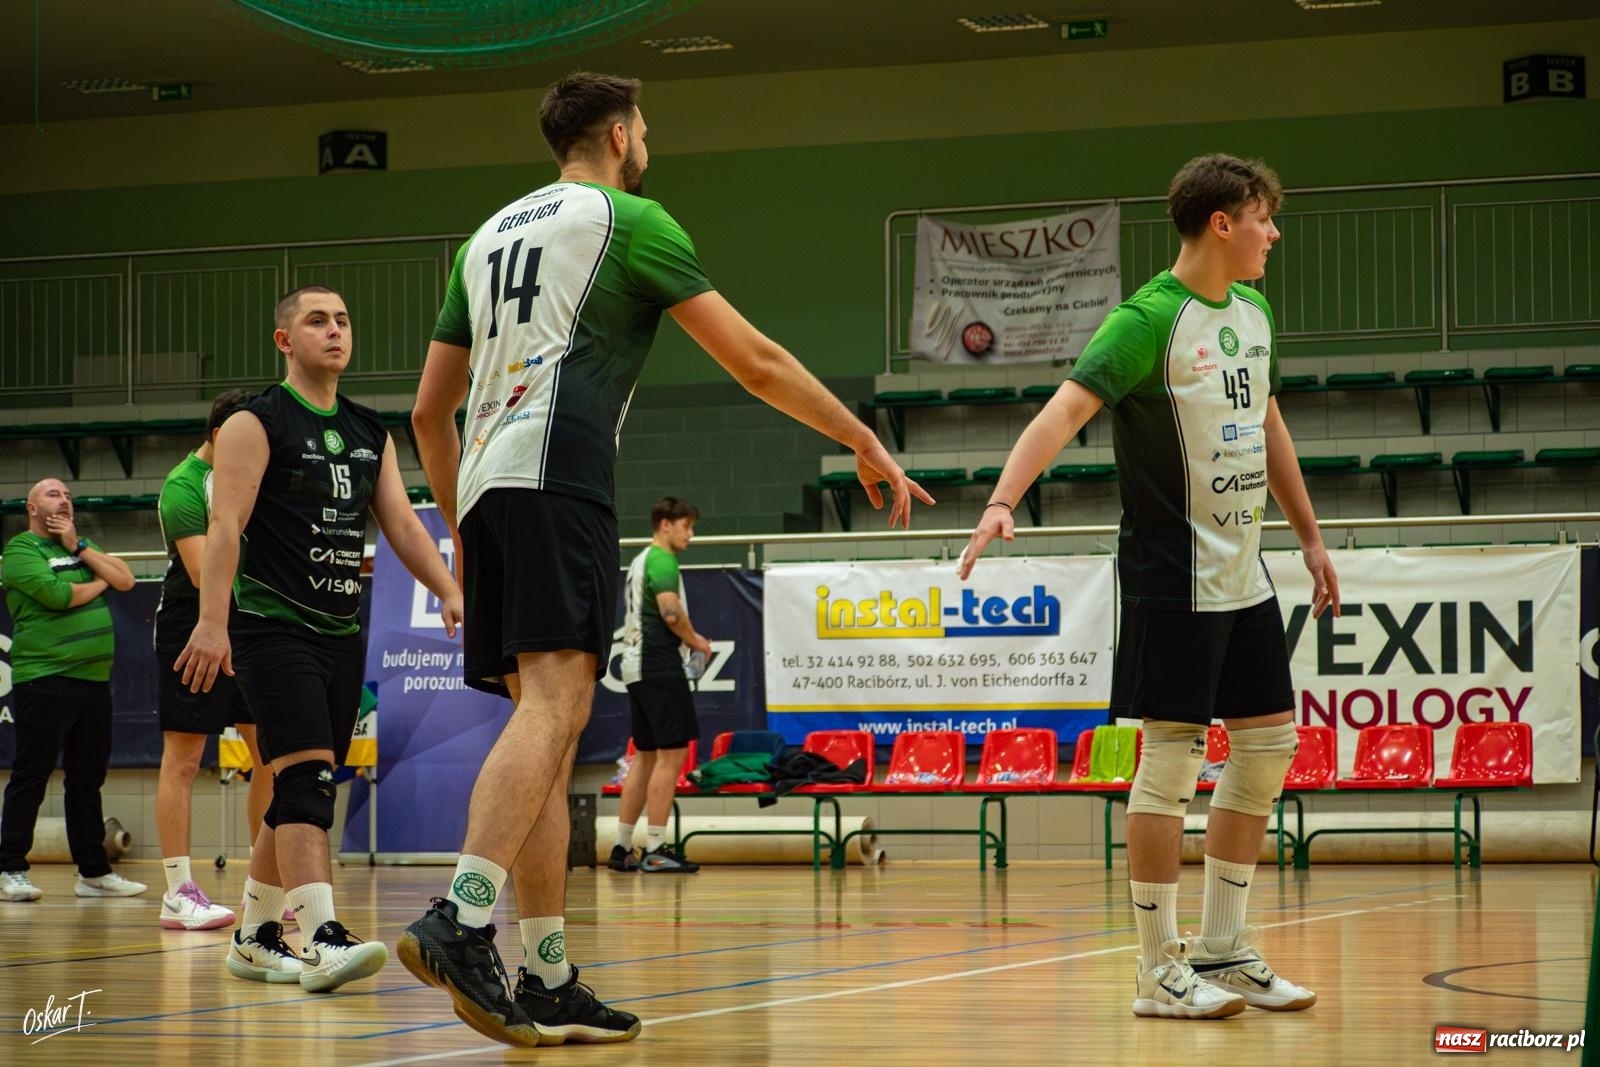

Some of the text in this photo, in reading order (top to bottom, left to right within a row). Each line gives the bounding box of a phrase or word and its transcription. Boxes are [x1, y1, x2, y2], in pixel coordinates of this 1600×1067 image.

[1511, 72, 1530, 97] B
[1548, 69, 1575, 93] B
[321, 145, 335, 170] A
[343, 143, 379, 166] A
[497, 200, 564, 233] GERLICH
[940, 217, 1096, 259] MIESZKO
[487, 237, 544, 340] 14
[942, 276, 990, 288] Operator
[942, 287, 999, 300] Pracownik
[1003, 304, 1051, 317] Czekamy
[1055, 302, 1069, 311] na
[1222, 367, 1251, 410] 45
[329, 462, 352, 500] 15
[1240, 470, 1265, 482] CONCEPT
[816, 583, 1061, 640] instal-tech
[382, 649, 453, 670] budujemy
[782, 652, 1097, 669] tel. 32 414 92 88, 502 632 695, 606 363 647
[404, 676, 472, 694] porozum
[792, 672, 1088, 689] 47-400 Racibórz, ul. J. von Eichendorffa 2
[1294, 687, 1534, 731] NOLOGY
